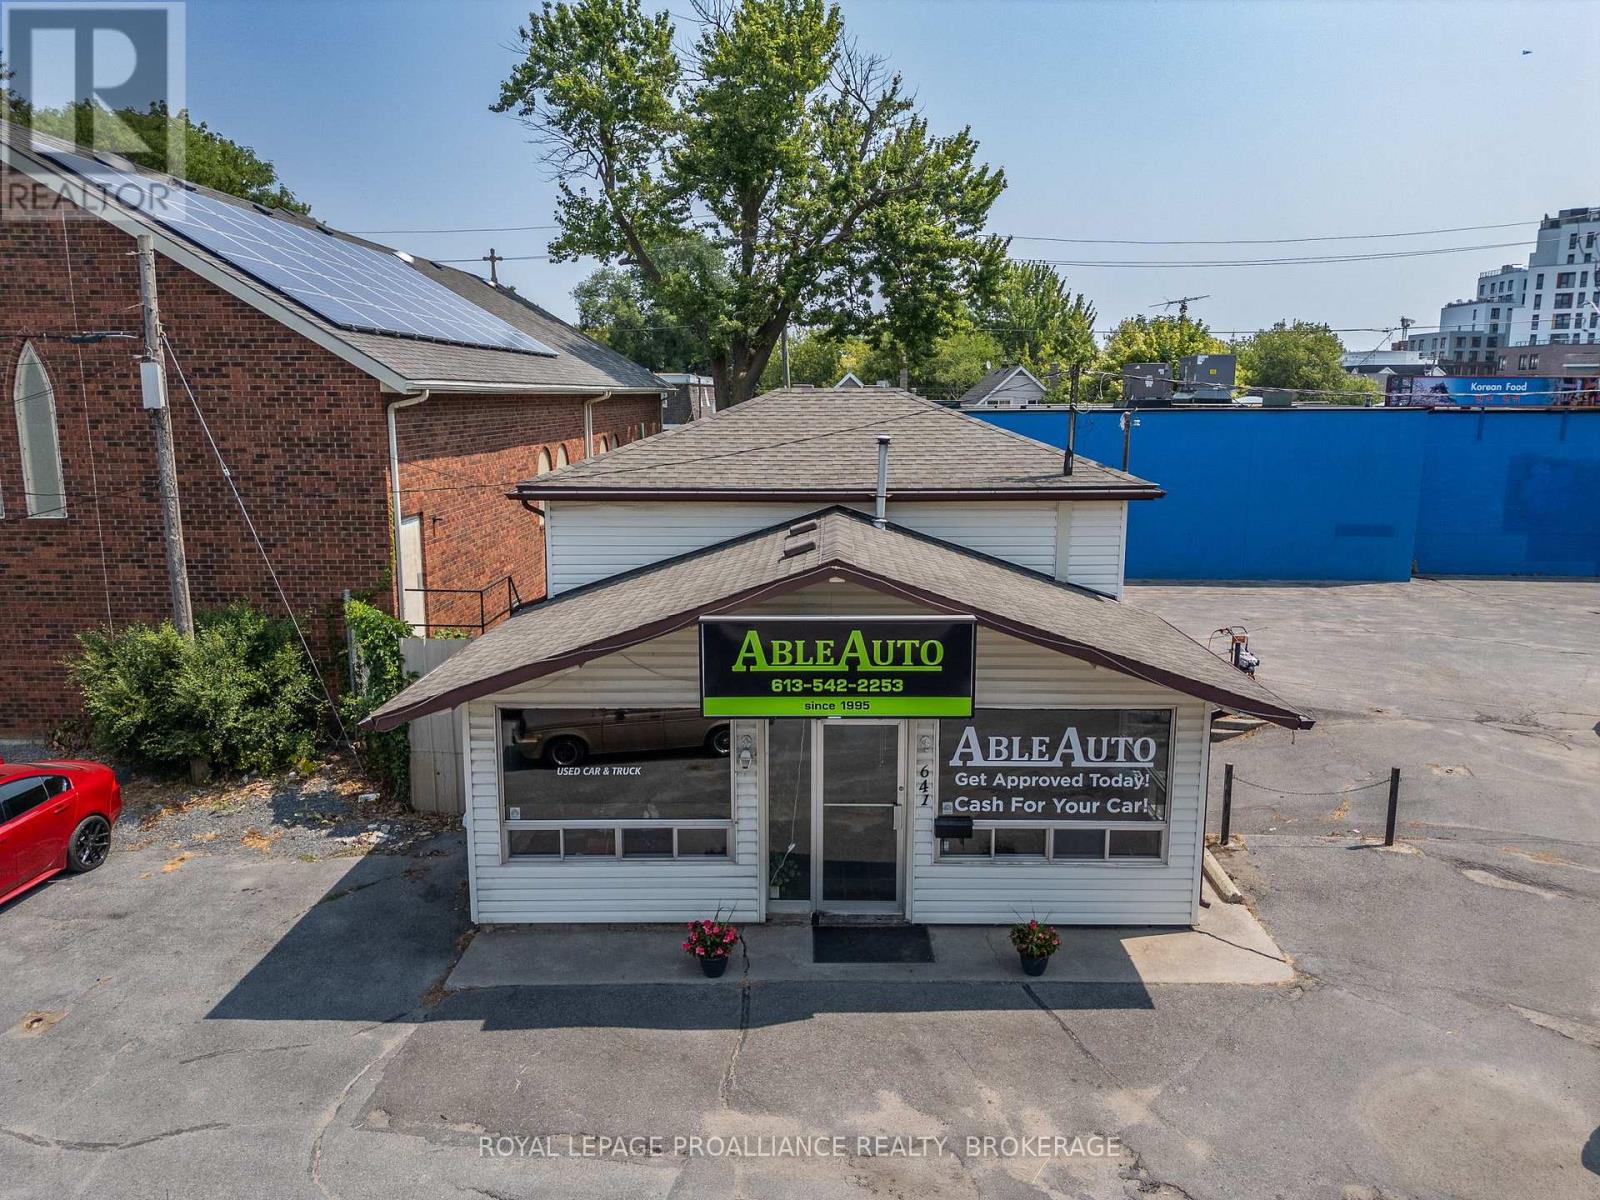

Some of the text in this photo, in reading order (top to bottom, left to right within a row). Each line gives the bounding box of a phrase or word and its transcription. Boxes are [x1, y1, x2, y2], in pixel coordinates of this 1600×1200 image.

[1471, 382, 1528, 391] Korean Food
[771, 679, 903, 692] 613-542-2253
[804, 701, 870, 710] since 1995
[557, 767, 642, 776] USED CAR & TRUCK
[918, 764, 930, 806] 641
[955, 773, 1150, 789] Get Approved Today!
[954, 796, 1149, 813] Cash For Your Car!
